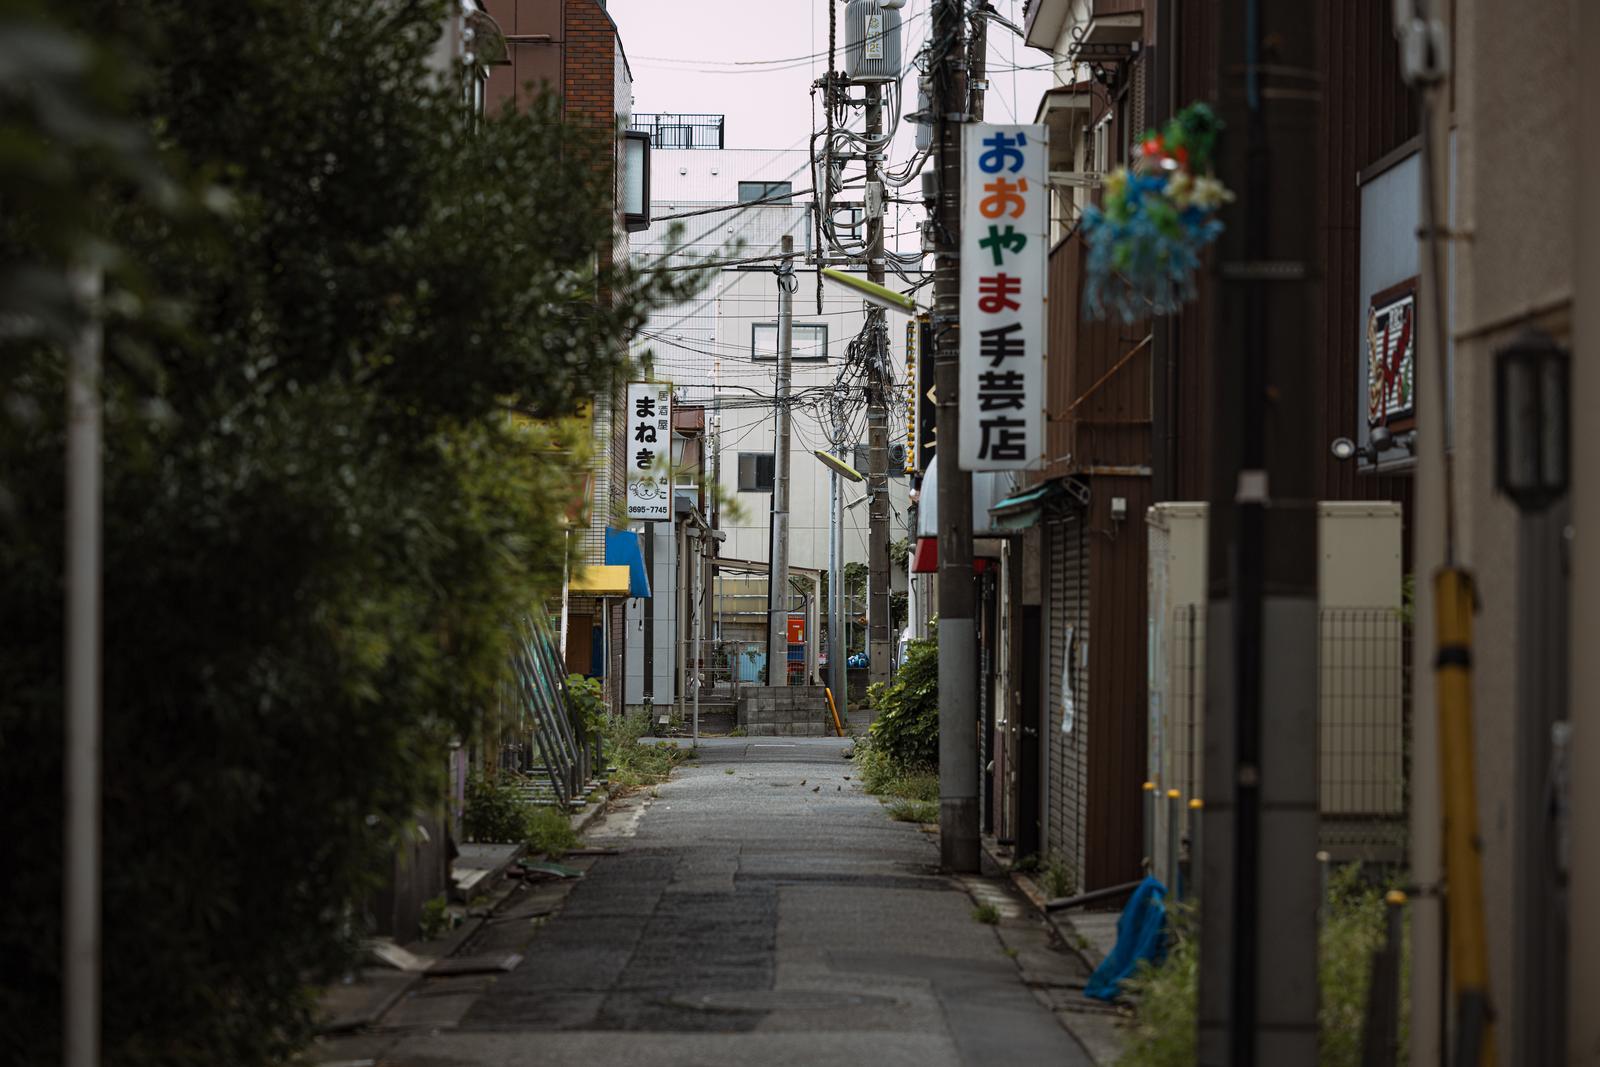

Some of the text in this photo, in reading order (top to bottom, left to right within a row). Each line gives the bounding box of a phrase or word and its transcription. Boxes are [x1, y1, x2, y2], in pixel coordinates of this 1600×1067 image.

[977, 131, 1028, 461] おおやま手芸店
[658, 390, 668, 430] 居酒屋
[635, 395, 657, 470] まねき
[659, 476, 668, 500] ねこ
[628, 505, 668, 514] 3695-7745
